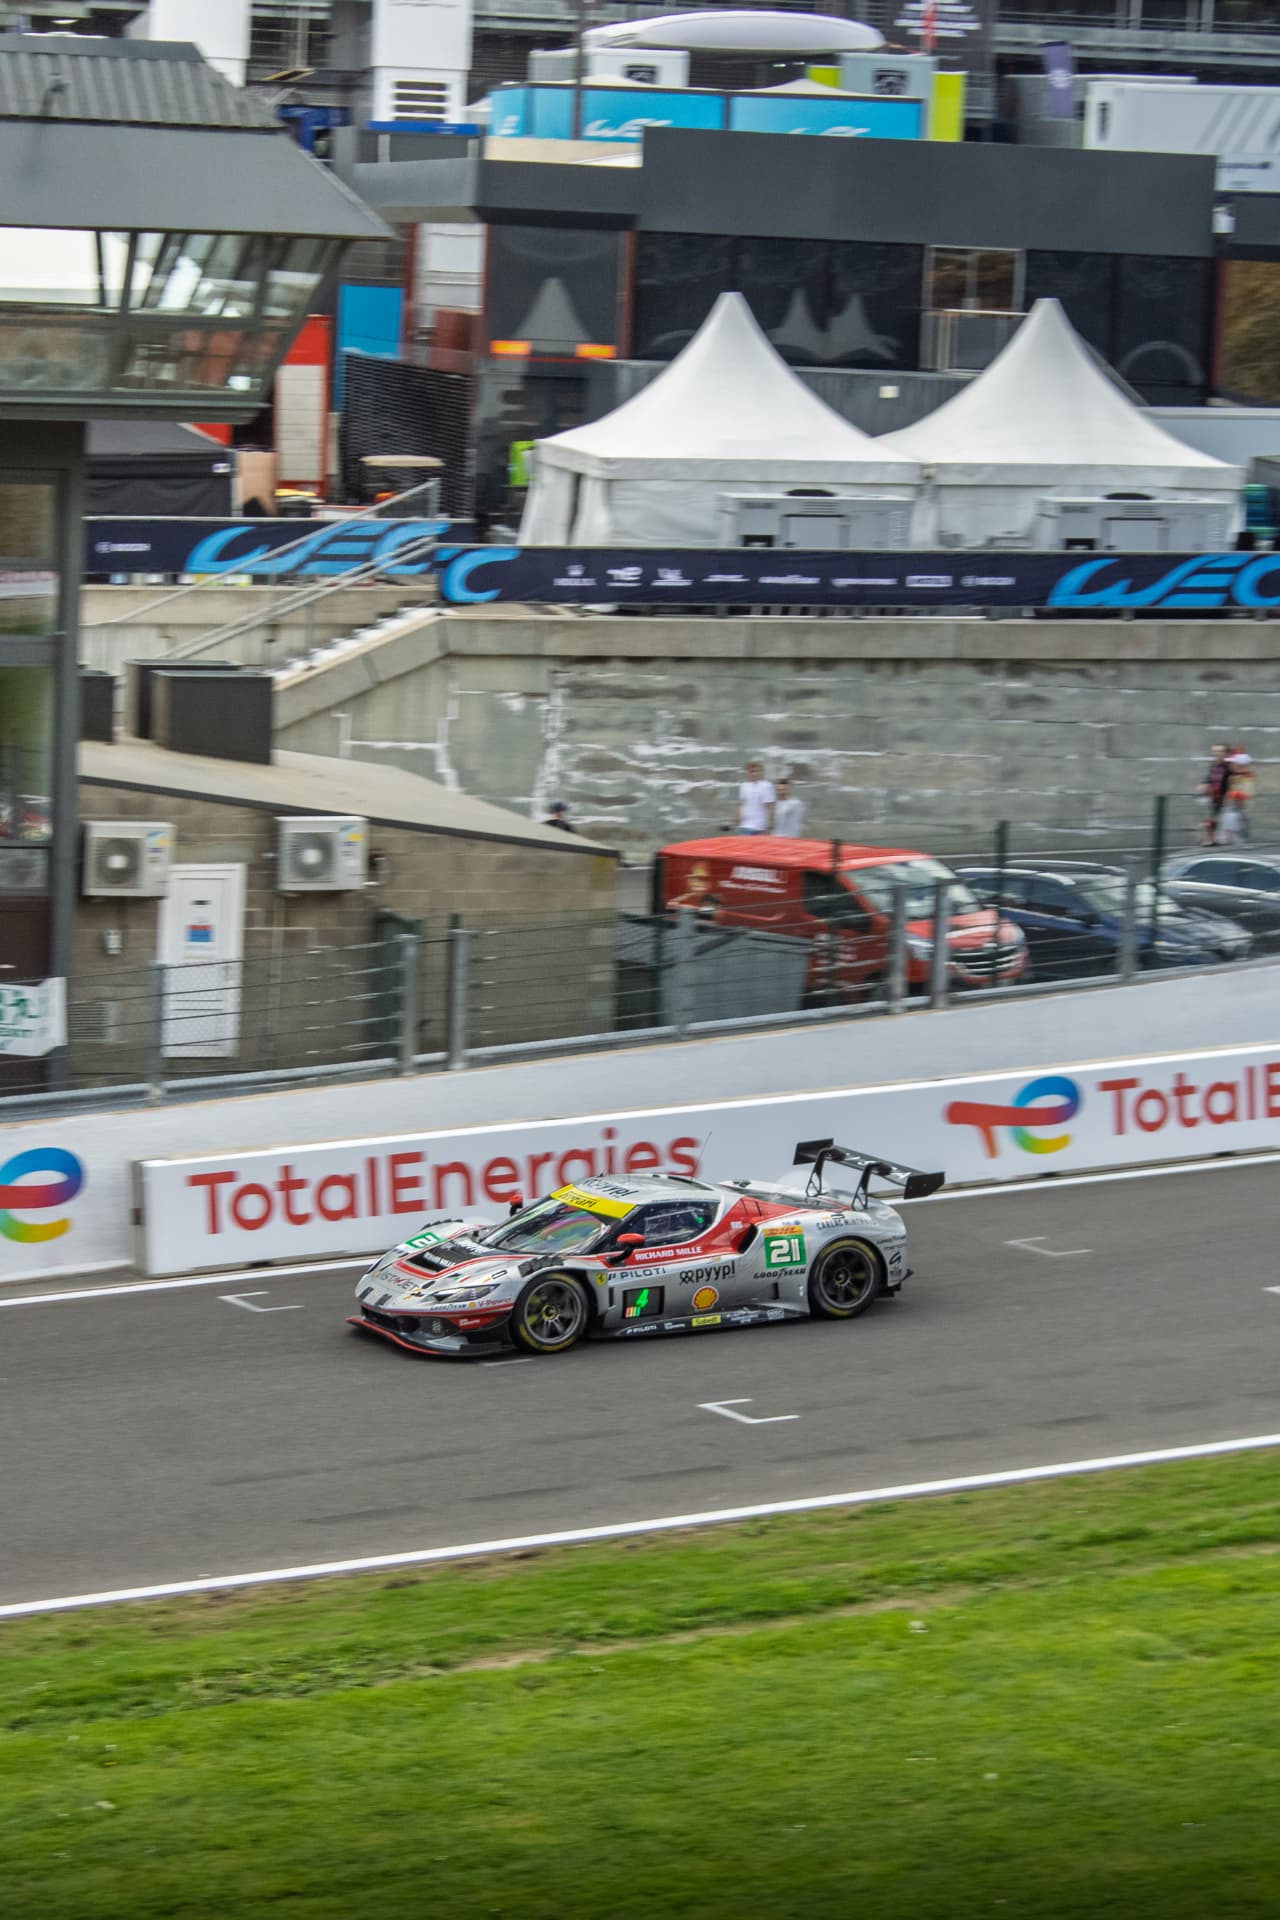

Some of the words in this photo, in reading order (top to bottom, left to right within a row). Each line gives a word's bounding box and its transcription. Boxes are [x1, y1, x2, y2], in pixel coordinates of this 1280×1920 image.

[186, 1126, 702, 1236] TotalEnergies
[635, 1249, 675, 1261] RICHARD
[676, 1246, 703, 1257] MILLE
[769, 1238, 801, 1264] 21
[620, 1267, 666, 1280] PILOTI
[695, 1261, 736, 1283] pyypl
